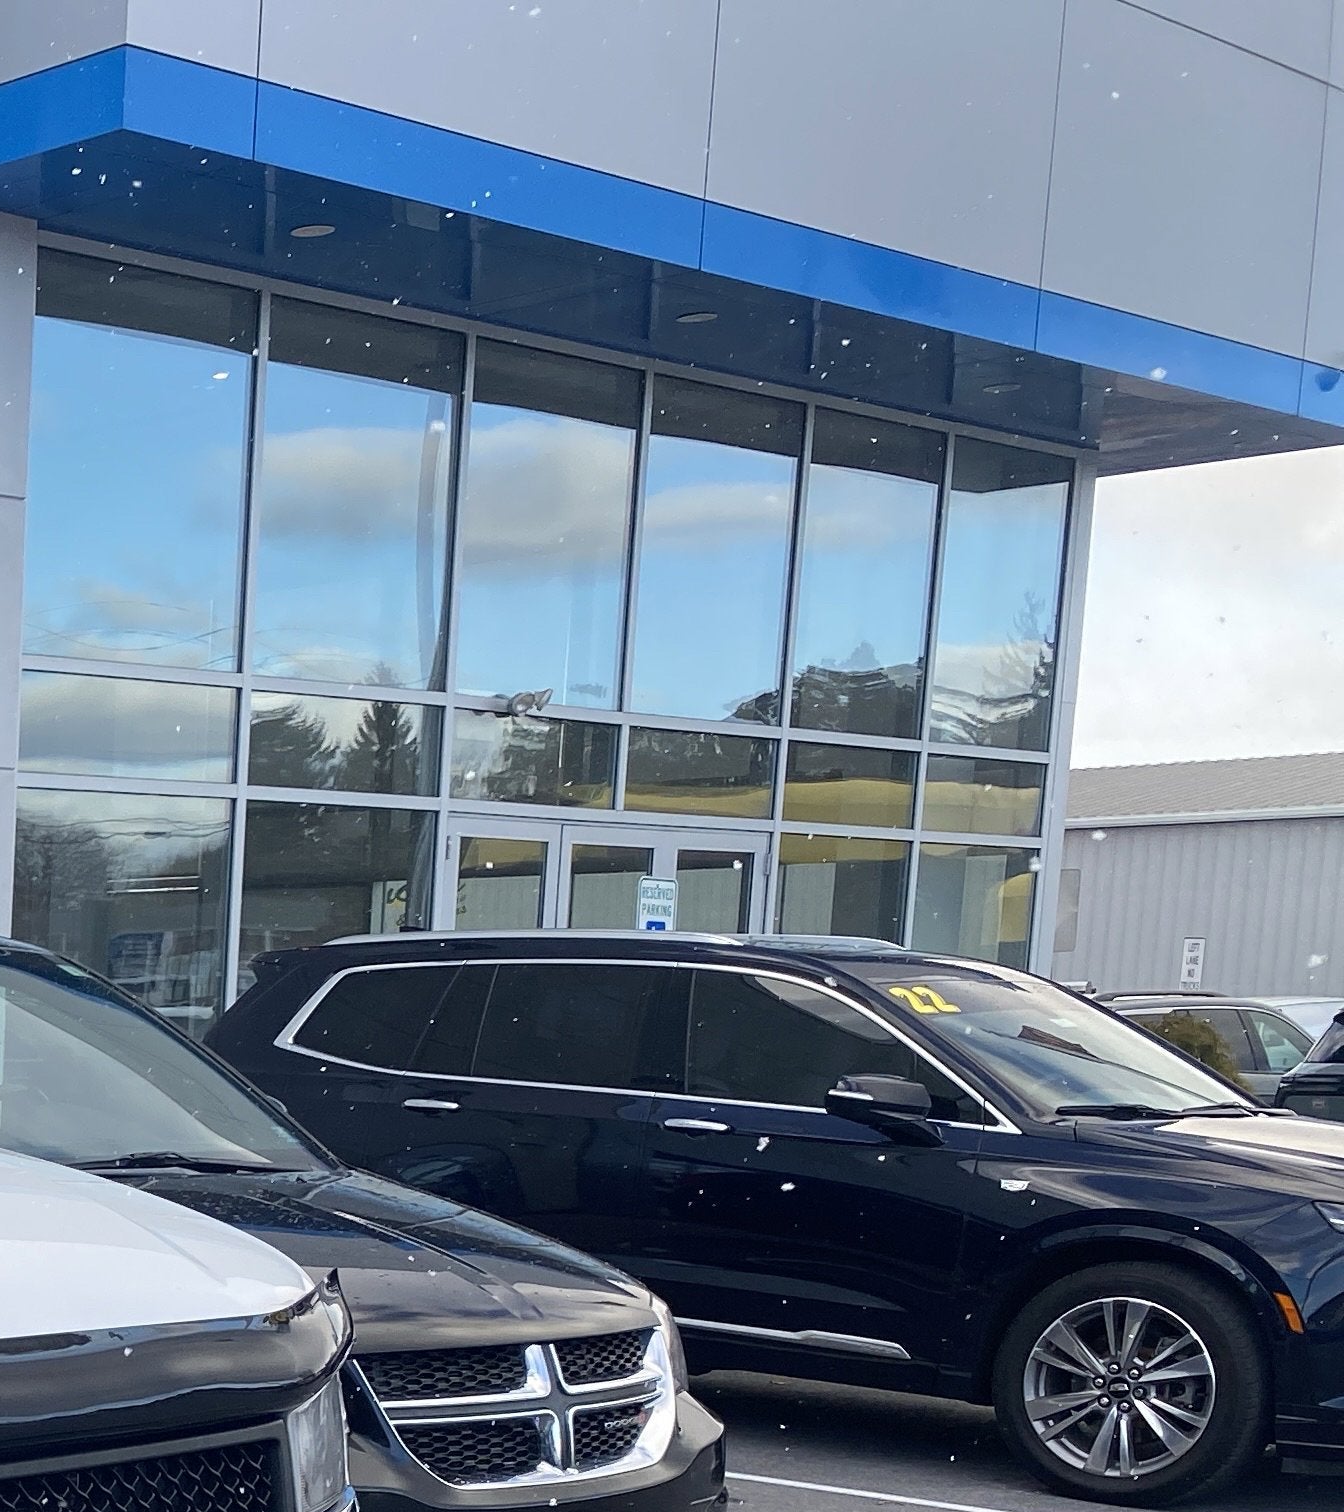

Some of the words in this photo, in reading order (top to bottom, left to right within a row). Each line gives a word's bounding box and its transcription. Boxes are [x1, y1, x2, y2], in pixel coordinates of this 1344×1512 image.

[642, 886, 673, 900] RESERVED
[641, 902, 672, 917] PARKING
[1185, 955, 1199, 965] LANE
[888, 985, 962, 1014] 22
